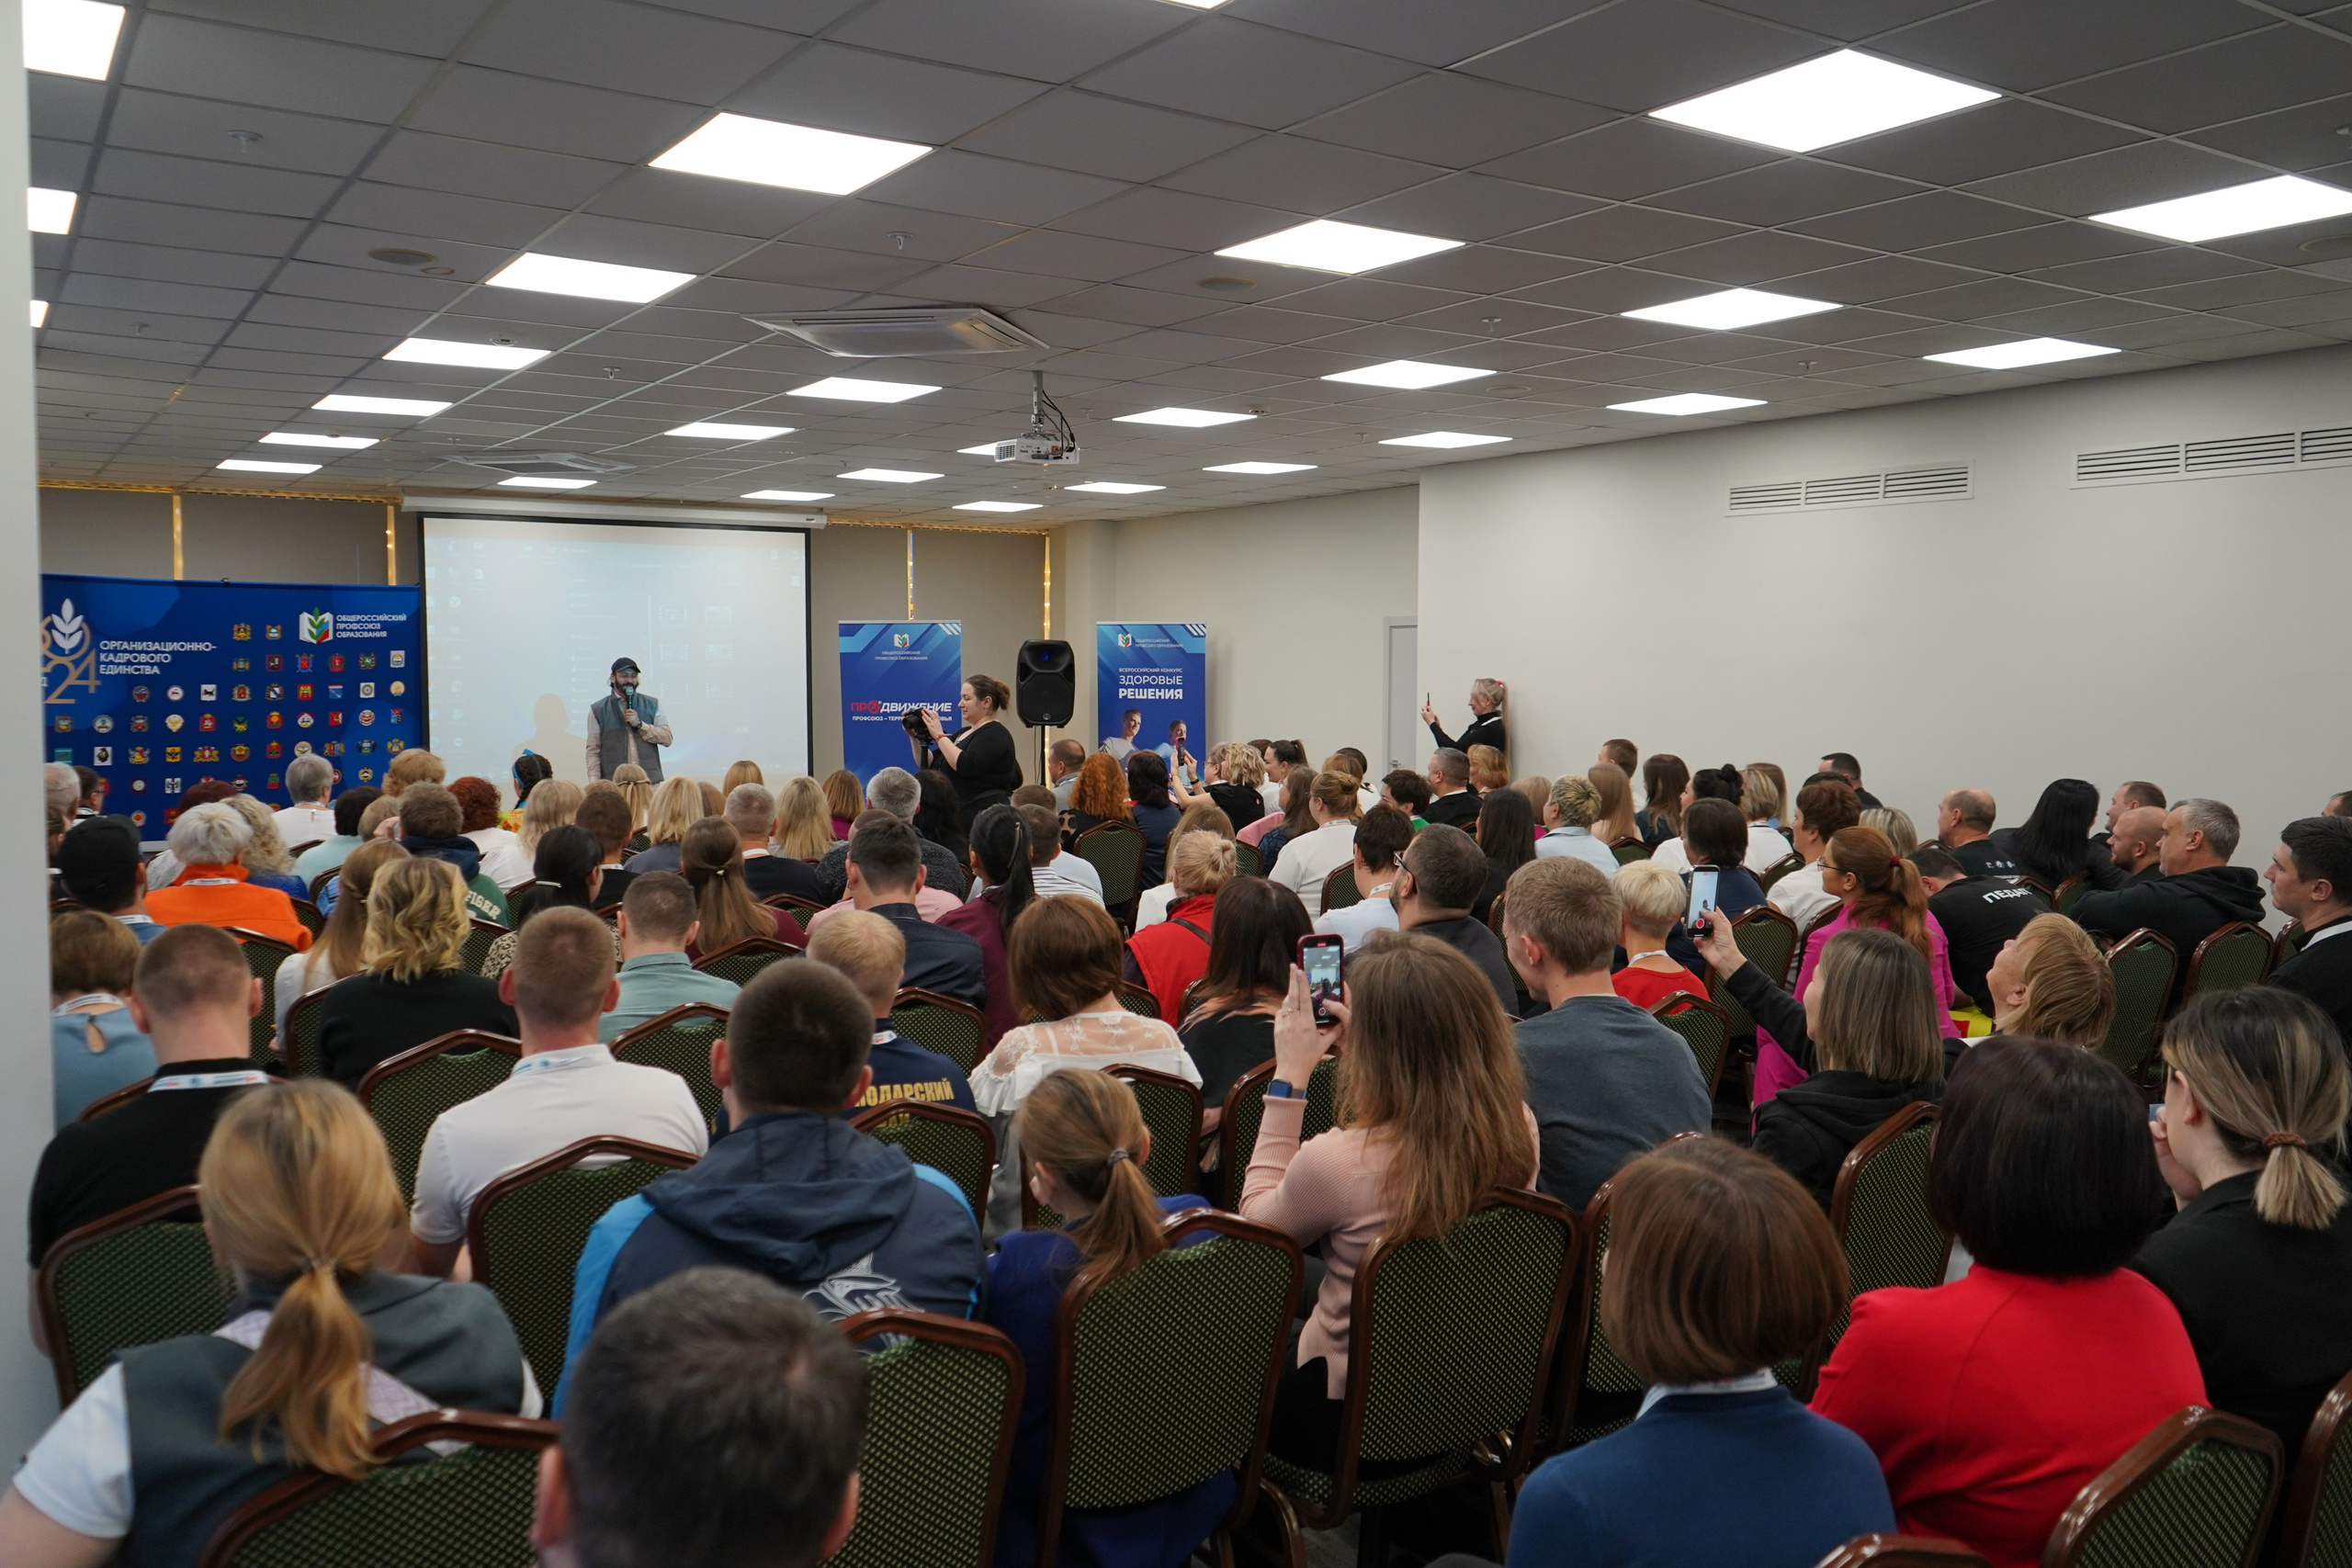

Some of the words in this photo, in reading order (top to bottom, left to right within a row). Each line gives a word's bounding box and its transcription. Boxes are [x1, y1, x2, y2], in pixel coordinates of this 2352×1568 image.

[336, 614, 406, 622] ОБЩЕРОССИЙСКИЙ
[99, 640, 217, 652] ОРГАНИЗАЦИОННО-
[99, 653, 172, 663] КАДРОВОГО
[99, 665, 161, 675] ЕДИНСТВА
[1119, 675, 1182, 685] ЗДОРОВЫЕ
[1119, 688, 1182, 700] РЕШЕНИЯ
[854, 1077, 955, 1108] ОДАРСКИЙ
